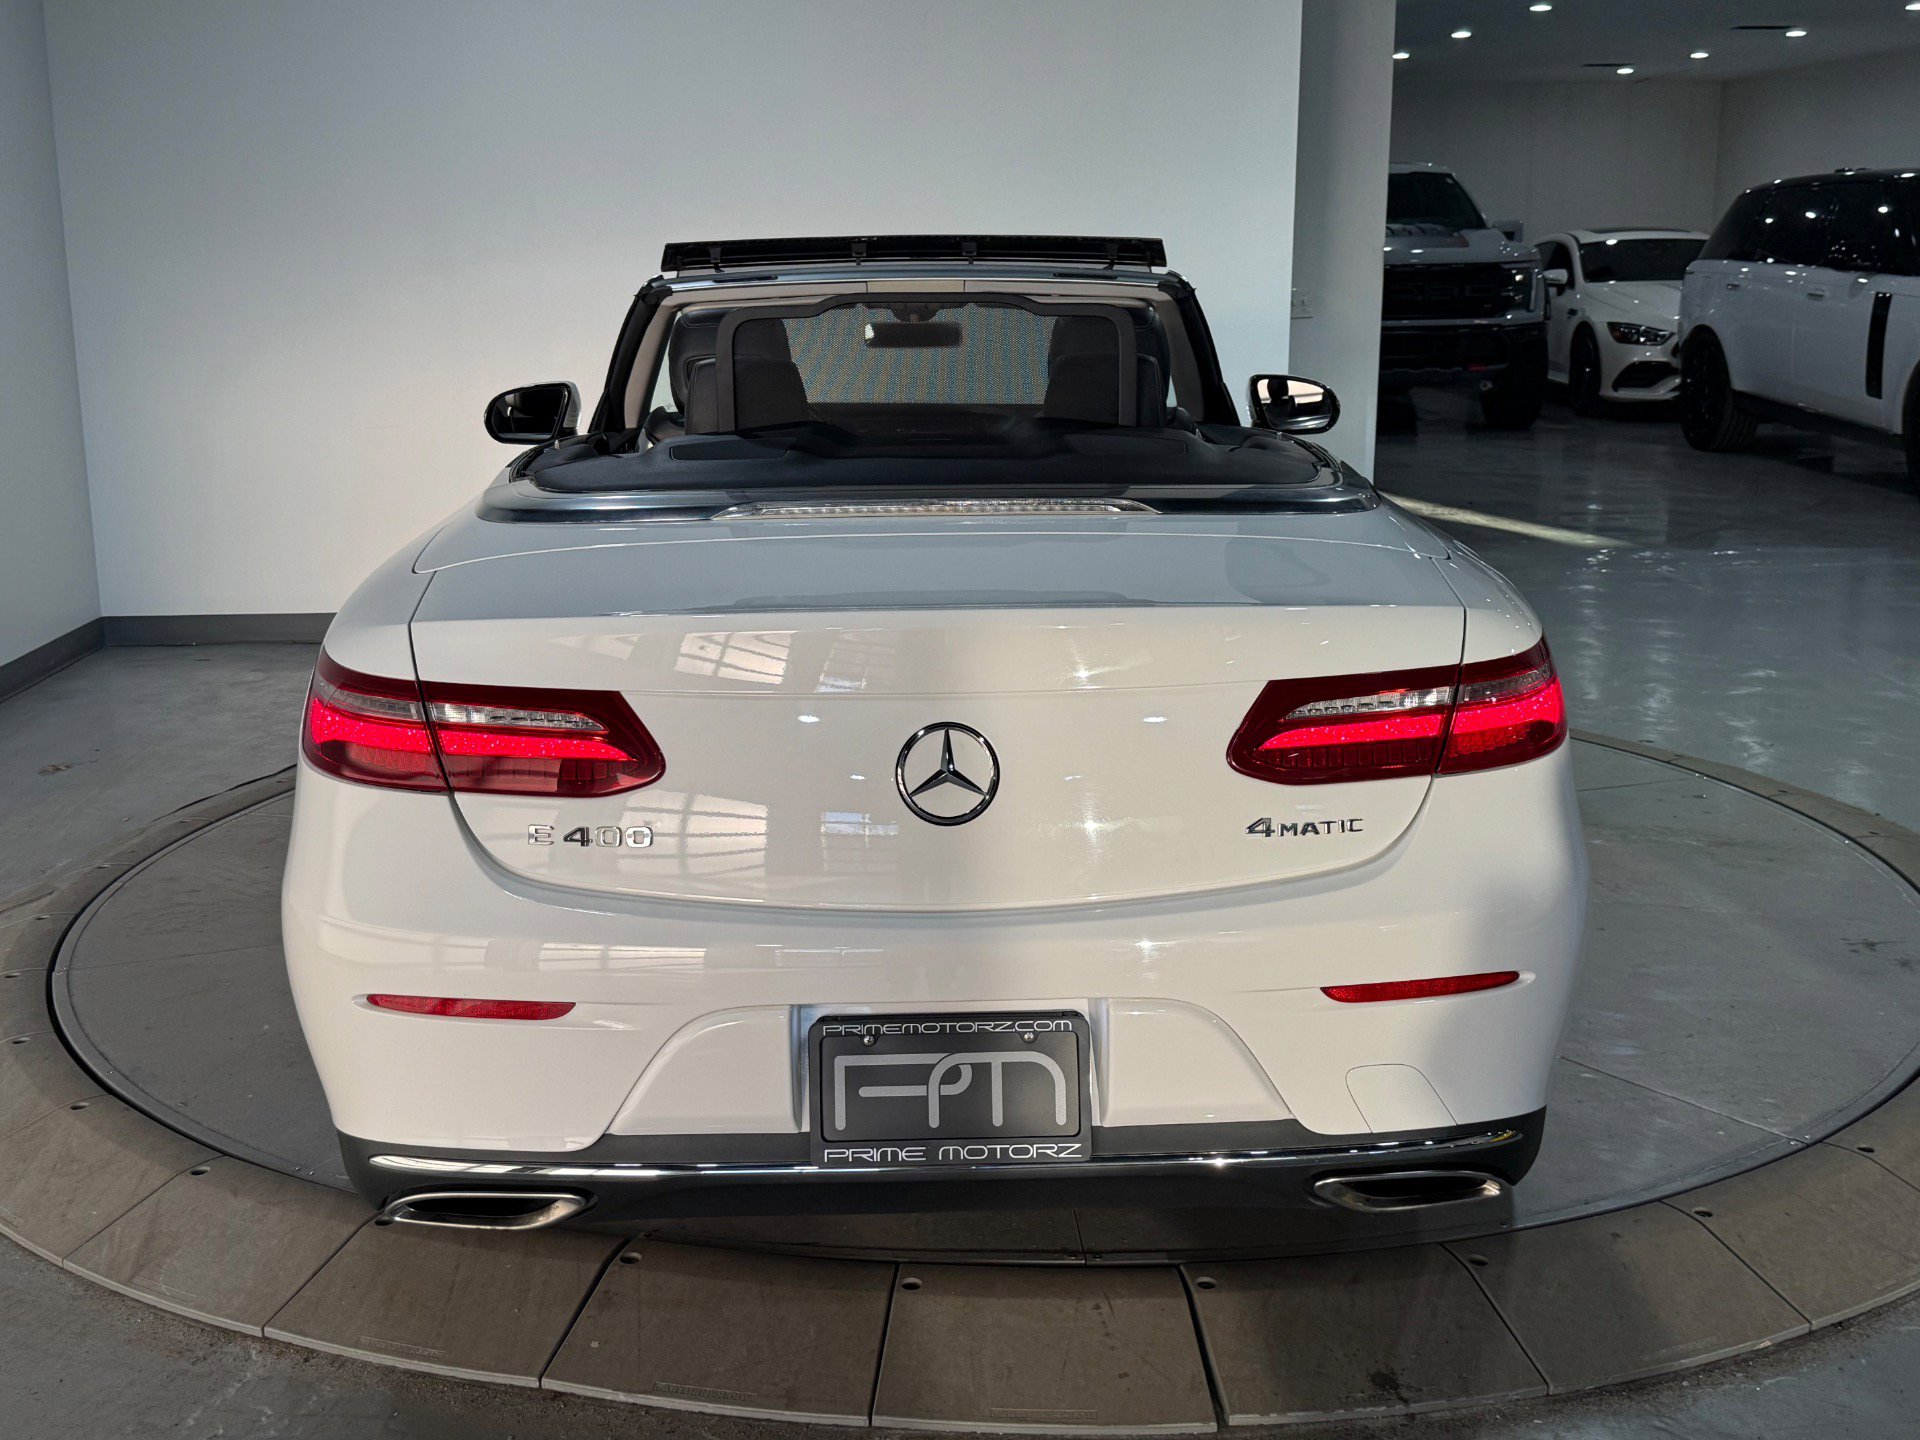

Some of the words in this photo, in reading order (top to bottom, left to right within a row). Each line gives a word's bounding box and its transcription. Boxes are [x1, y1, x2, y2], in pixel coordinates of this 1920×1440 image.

[528, 823, 554, 845] E
[563, 825, 654, 848] 400
[1245, 817, 1364, 837] 4MATIC
[823, 1020, 1072, 1036] PRIMEMOTORZ.COM
[824, 1146, 927, 1162] PRIME
[939, 1143, 1083, 1160] MOTORZ
